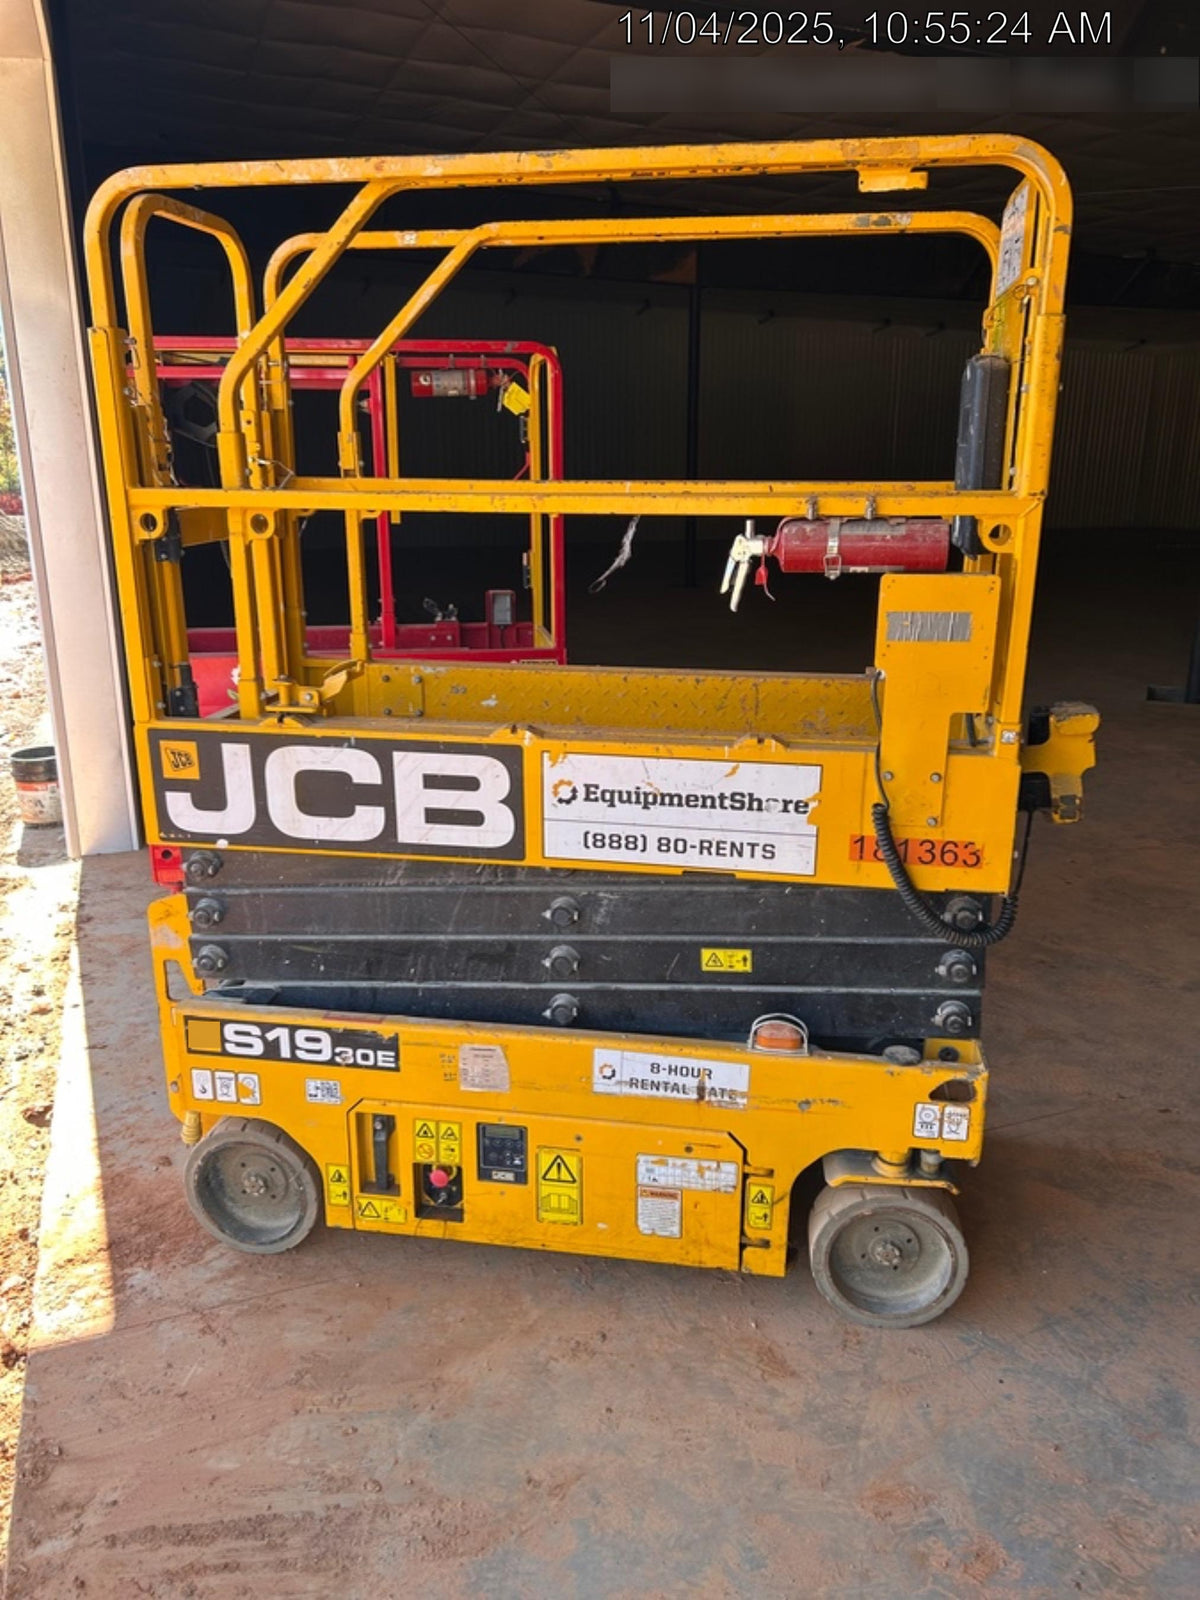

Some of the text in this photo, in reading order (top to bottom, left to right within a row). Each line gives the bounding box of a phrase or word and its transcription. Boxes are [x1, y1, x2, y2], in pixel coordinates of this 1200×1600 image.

[170, 750, 193, 769] JCB
[164, 743, 516, 849] JCB
[583, 783, 810, 815] EquipmentShre
[583, 830, 777, 860] (888) 80-RENTS
[650, 1062, 713, 1080] 8-HOUR
[629, 1077, 738, 1101] RENTAL ATE
